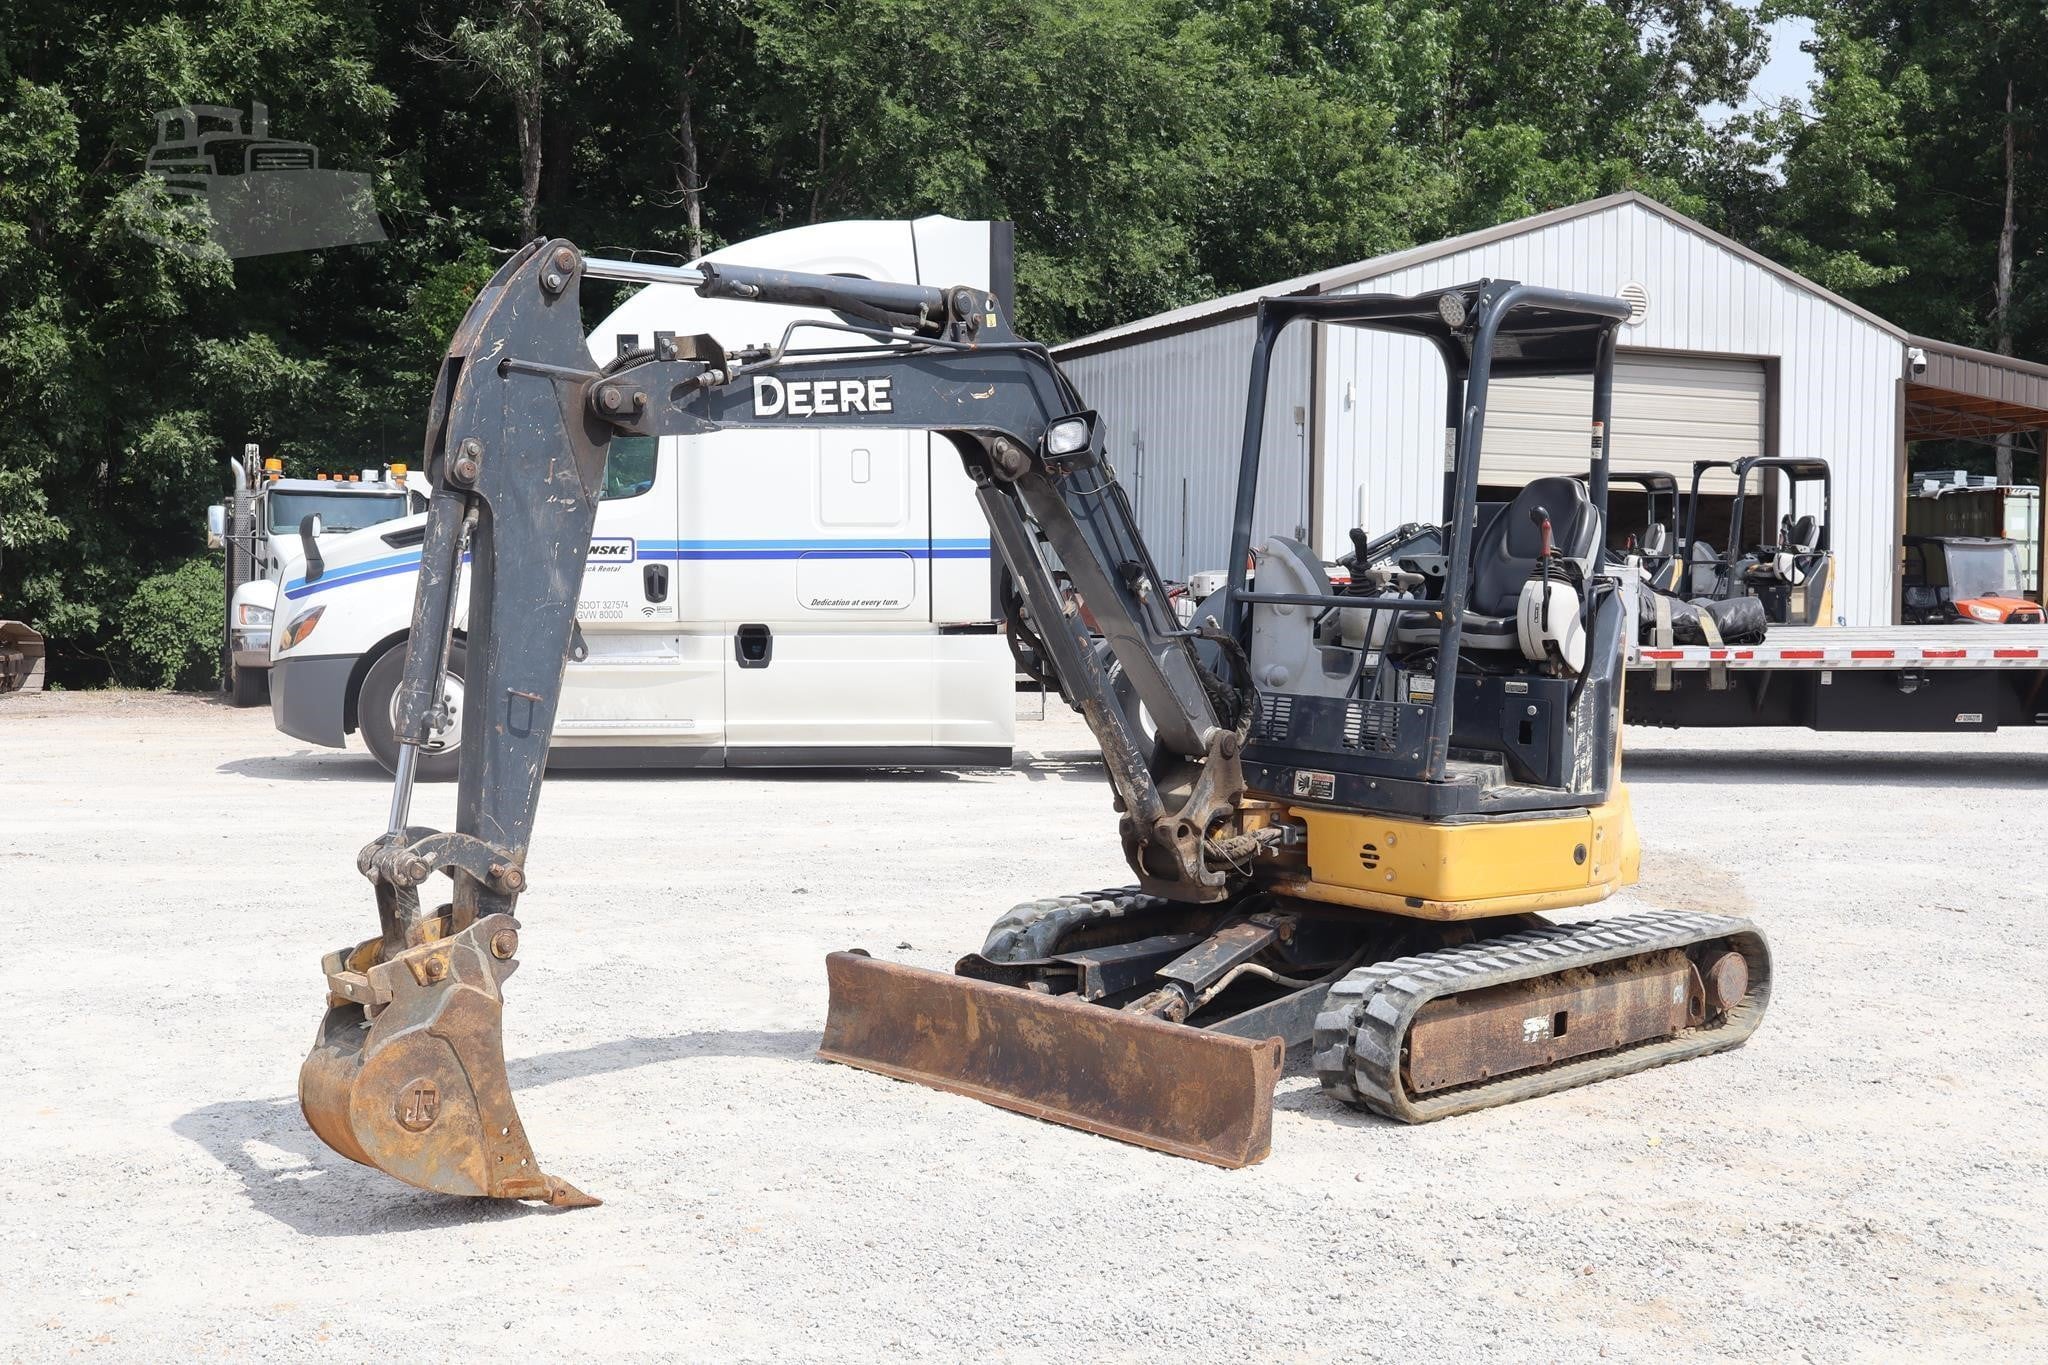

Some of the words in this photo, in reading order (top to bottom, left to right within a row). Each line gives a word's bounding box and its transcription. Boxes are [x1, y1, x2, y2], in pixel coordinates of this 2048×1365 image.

[753, 375, 892, 416] DEERE
[588, 545, 629, 555] NSKE
[577, 600, 600, 609] SDOT
[811, 598, 850, 606] Dedication
[860, 599, 882, 607] every
[576, 610, 597, 619] GVW
[599, 610, 624, 619] 80000
